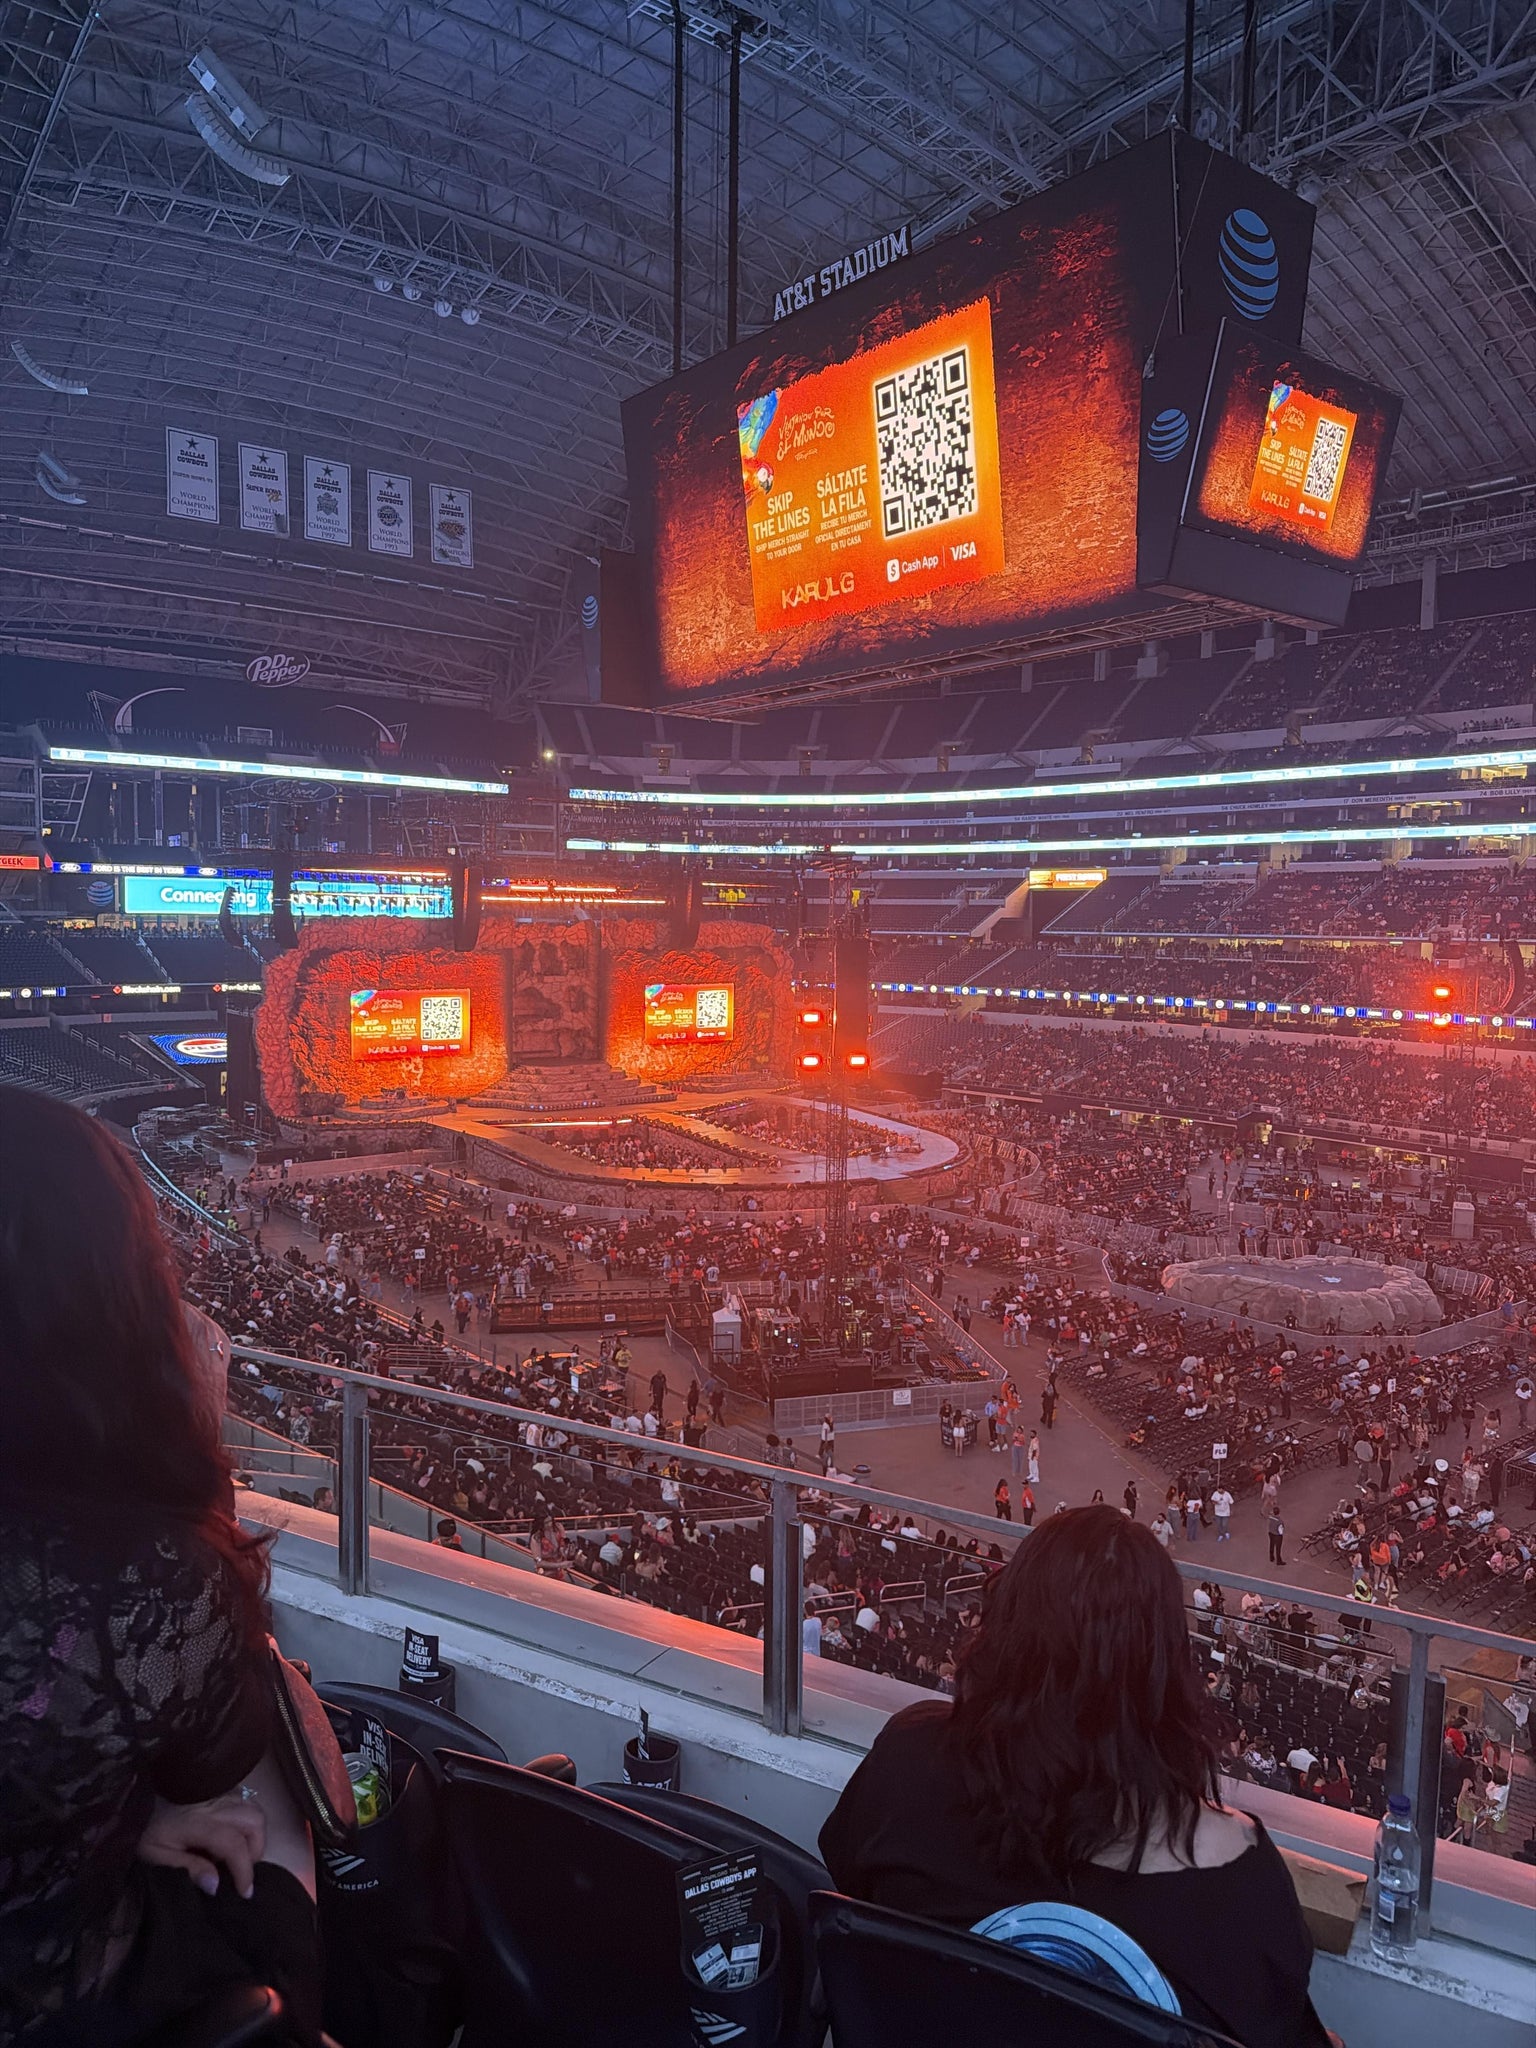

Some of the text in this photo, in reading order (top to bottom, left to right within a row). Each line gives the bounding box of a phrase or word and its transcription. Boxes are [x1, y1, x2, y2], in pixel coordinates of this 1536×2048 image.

[774, 226, 908, 321] AT&T STADIUM
[793, 420, 835, 448] MUNDO
[180, 449, 206, 460] DALLAS
[177, 456, 208, 468] COWBOYS
[252, 464, 276, 474] DALLAS
[249, 470, 278, 481] COWBOYS
[316, 476, 340, 486] DALLAS
[816, 464, 868, 499] SÁLTATE
[246, 484, 264, 494] SUPER
[314, 483, 342, 494] COWBOYS
[180, 491, 206, 502] WORLD
[379, 490, 400, 499] DALLAS
[172, 496, 215, 512] CHAMPIONS
[376, 496, 404, 506] COWBOYS
[768, 491, 793, 516] SKIP
[821, 488, 866, 518] LA FILA
[186, 508, 202, 516] 1971
[252, 505, 278, 514] WORLD
[440, 502, 462, 512] DALLAS
[438, 508, 464, 518] COWBOYS
[316, 516, 340, 526] WORLD
[753, 506, 810, 540] THE LINES
[308, 522, 348, 535] CHAMPIONS
[379, 528, 402, 538] WORLD
[321, 532, 336, 540] 1992
[372, 534, 410, 546] CHAMPIONS
[902, 542, 977, 574] Cash App VISA
[271, 654, 295, 670] Dr
[251, 656, 306, 684] Pepper
[0, 857, 24, 866] GEEK
[93, 862, 112, 872] FORD
[412, 1634, 424, 1646] VISA
[408, 1641, 430, 1656] IN-SEAT
[406, 1650, 432, 1666] DELIVERY
[338, 1880, 380, 1891] AMERICA
[684, 1867, 757, 1900] DALLAS COWBOYS APP
